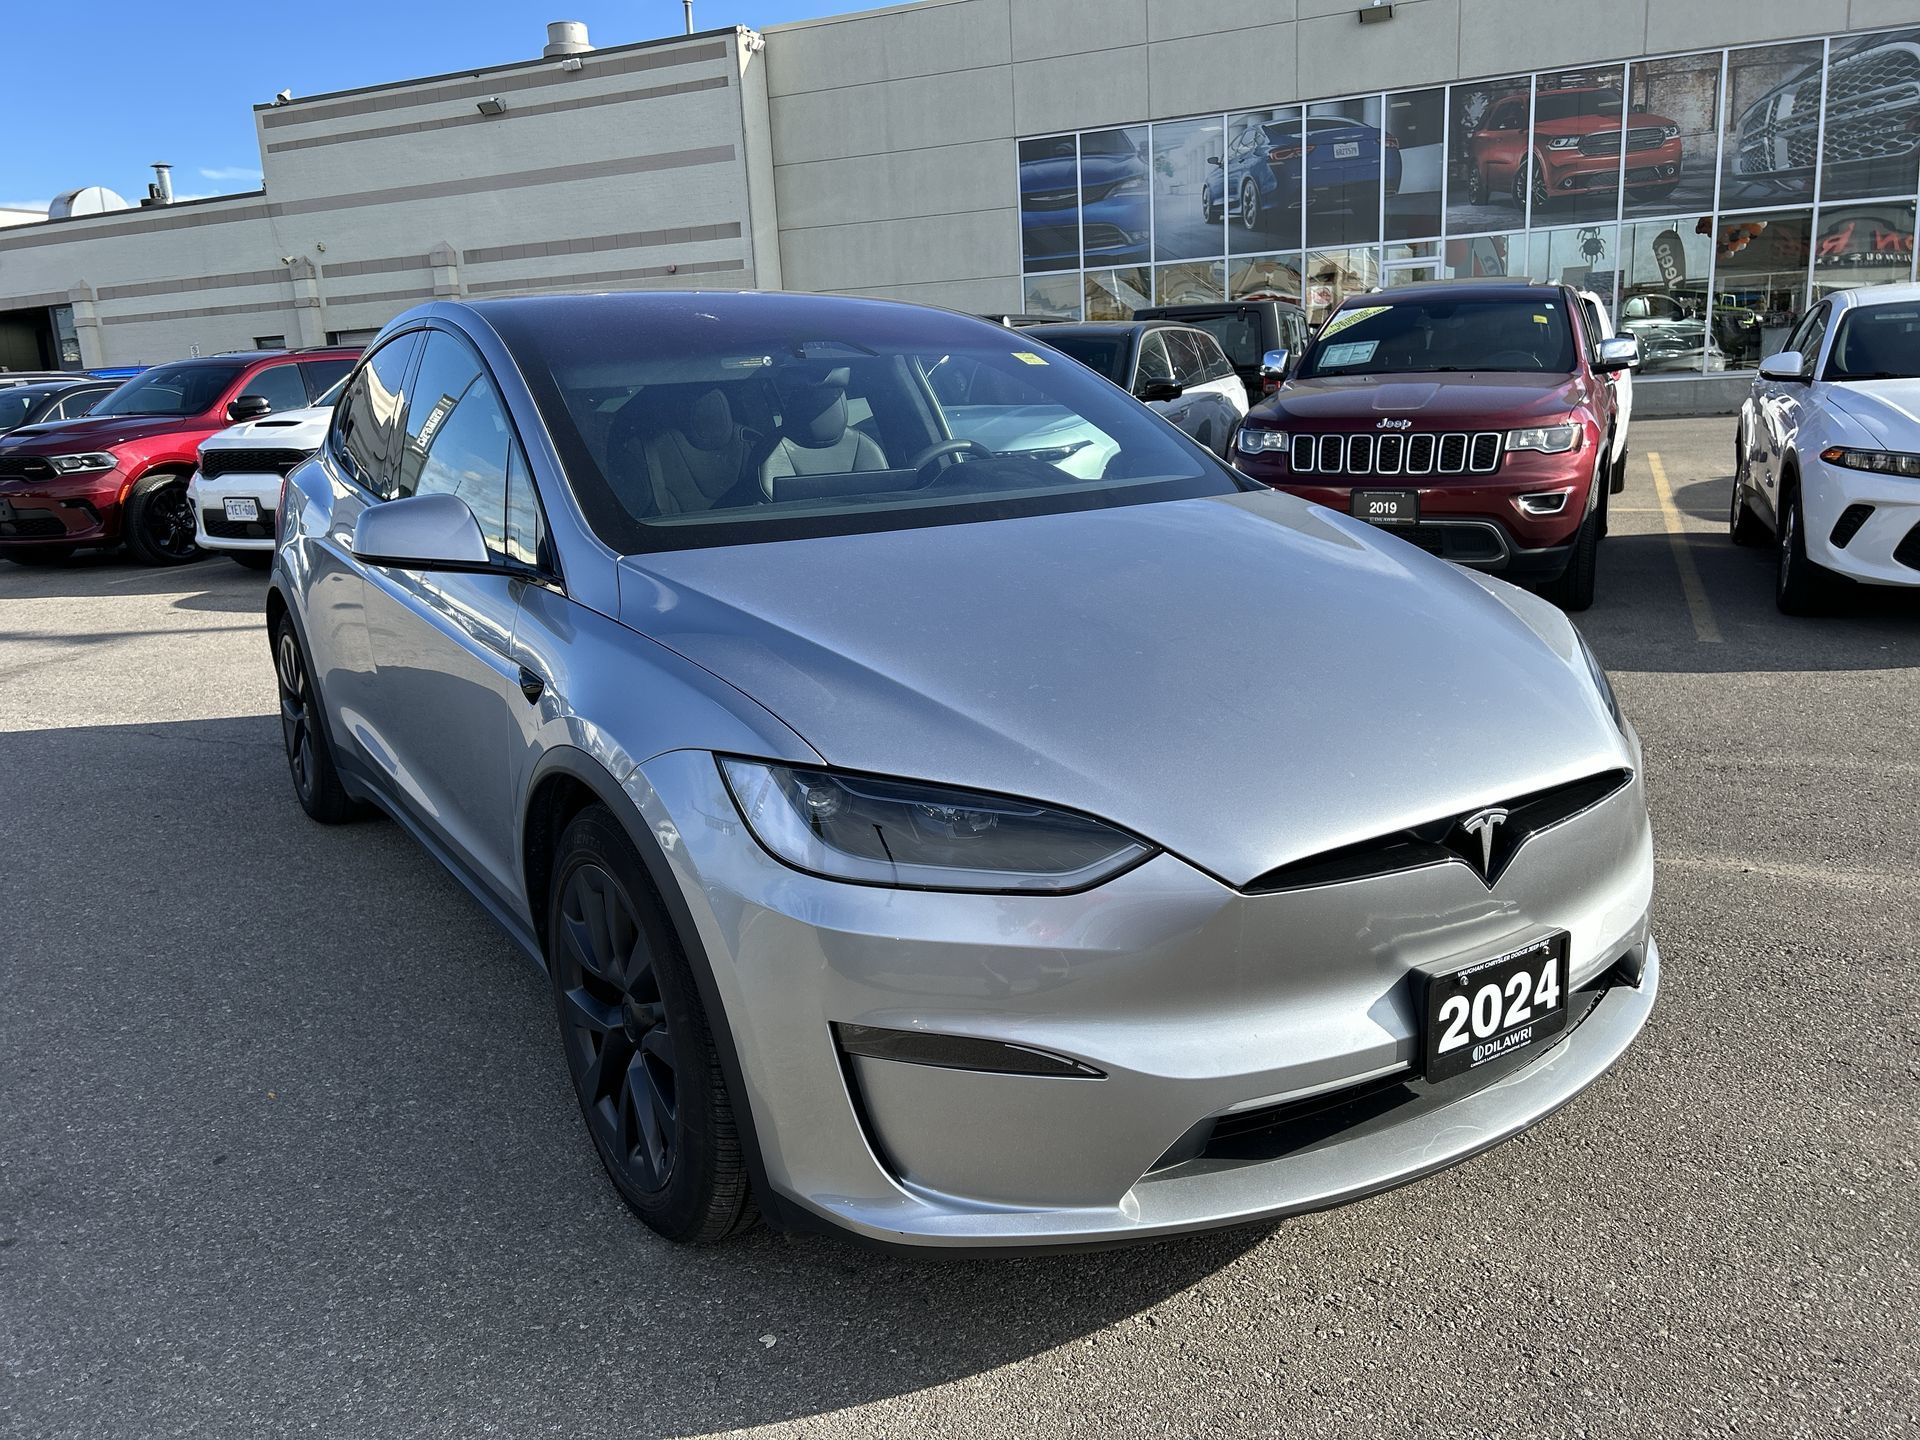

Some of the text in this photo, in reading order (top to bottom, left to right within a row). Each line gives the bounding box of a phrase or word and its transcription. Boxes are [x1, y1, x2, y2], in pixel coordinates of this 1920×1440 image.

[1842, 124, 1905, 140] DODGE
[1376, 417, 1412, 430] Jeep
[1369, 501, 1397, 514] 2019
[1457, 964, 1484, 977] VAUGHAN
[1511, 948, 1528, 959] DODGE
[1438, 957, 1560, 1054] 2024
[1484, 1026, 1532, 1056] DILAWRI
